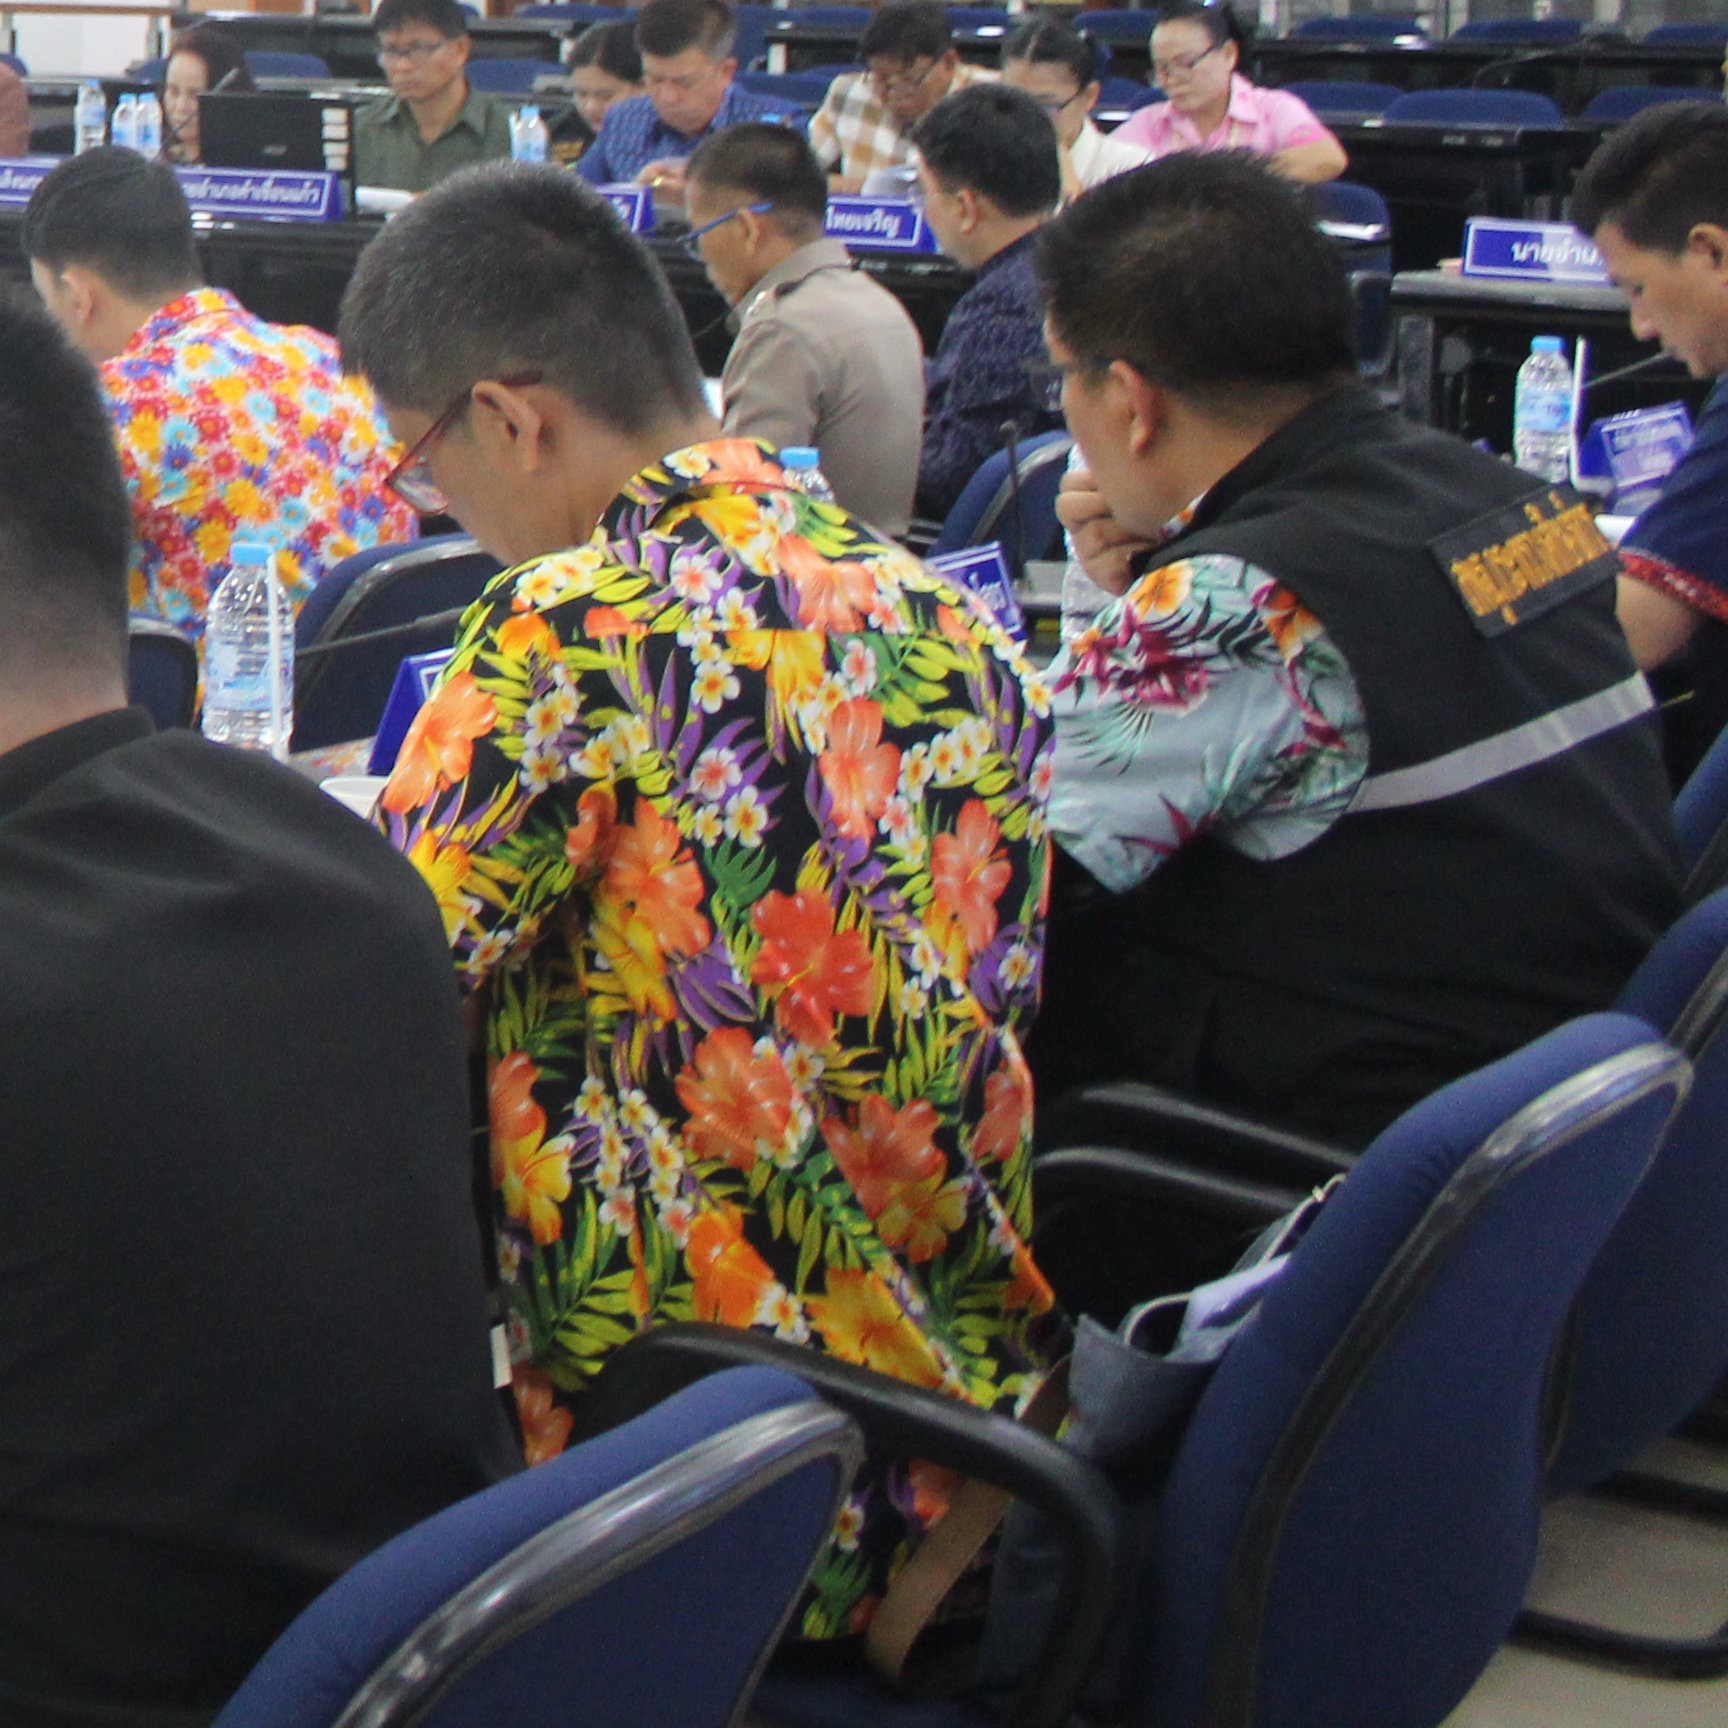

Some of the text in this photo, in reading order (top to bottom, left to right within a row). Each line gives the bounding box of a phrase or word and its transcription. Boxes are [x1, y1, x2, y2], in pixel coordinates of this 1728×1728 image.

[181, 176, 322, 204] ยอำเภอคำเขื่อนแก้ว
[825, 204, 901, 238] ไทยเจริญ
